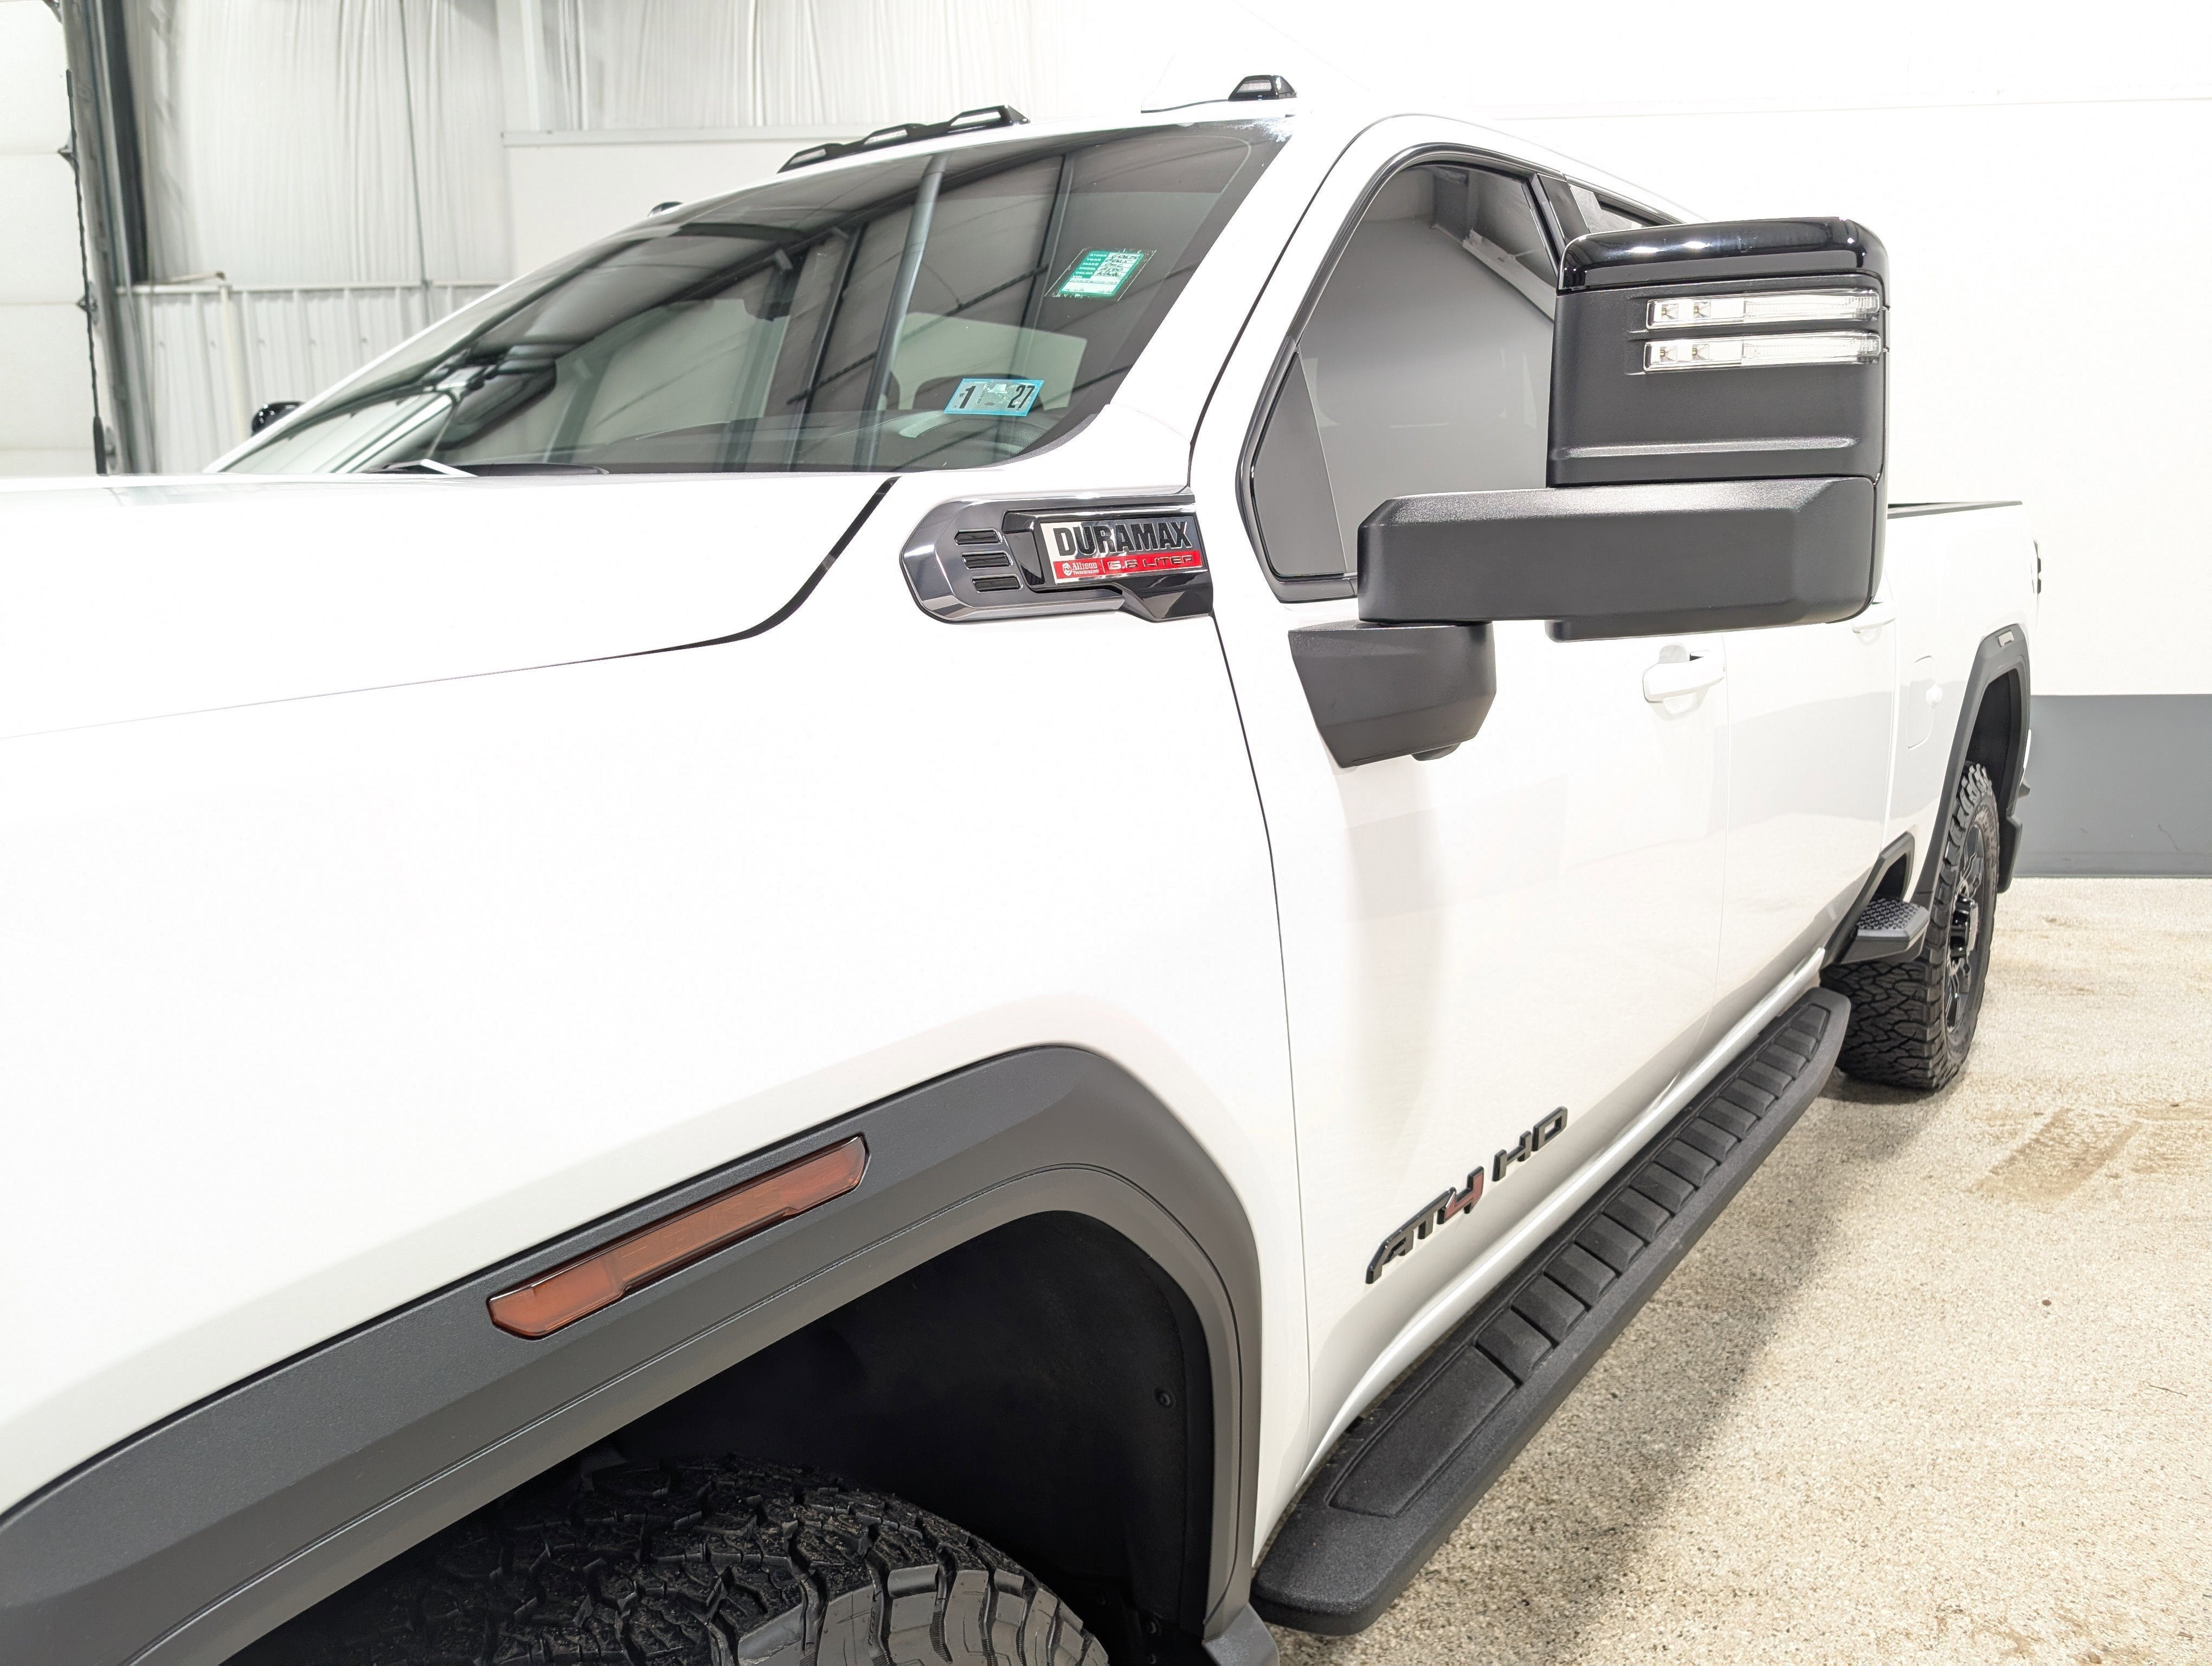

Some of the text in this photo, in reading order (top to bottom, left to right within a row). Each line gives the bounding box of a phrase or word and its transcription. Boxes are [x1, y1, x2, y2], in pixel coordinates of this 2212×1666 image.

[959, 386, 976, 409] 1
[1007, 385, 1036, 409] 27
[1053, 521, 1193, 556] DURAMAX
[1107, 555, 1194, 570] 6.6 LITER
[1365, 1106, 1568, 1285] AT4 HD
